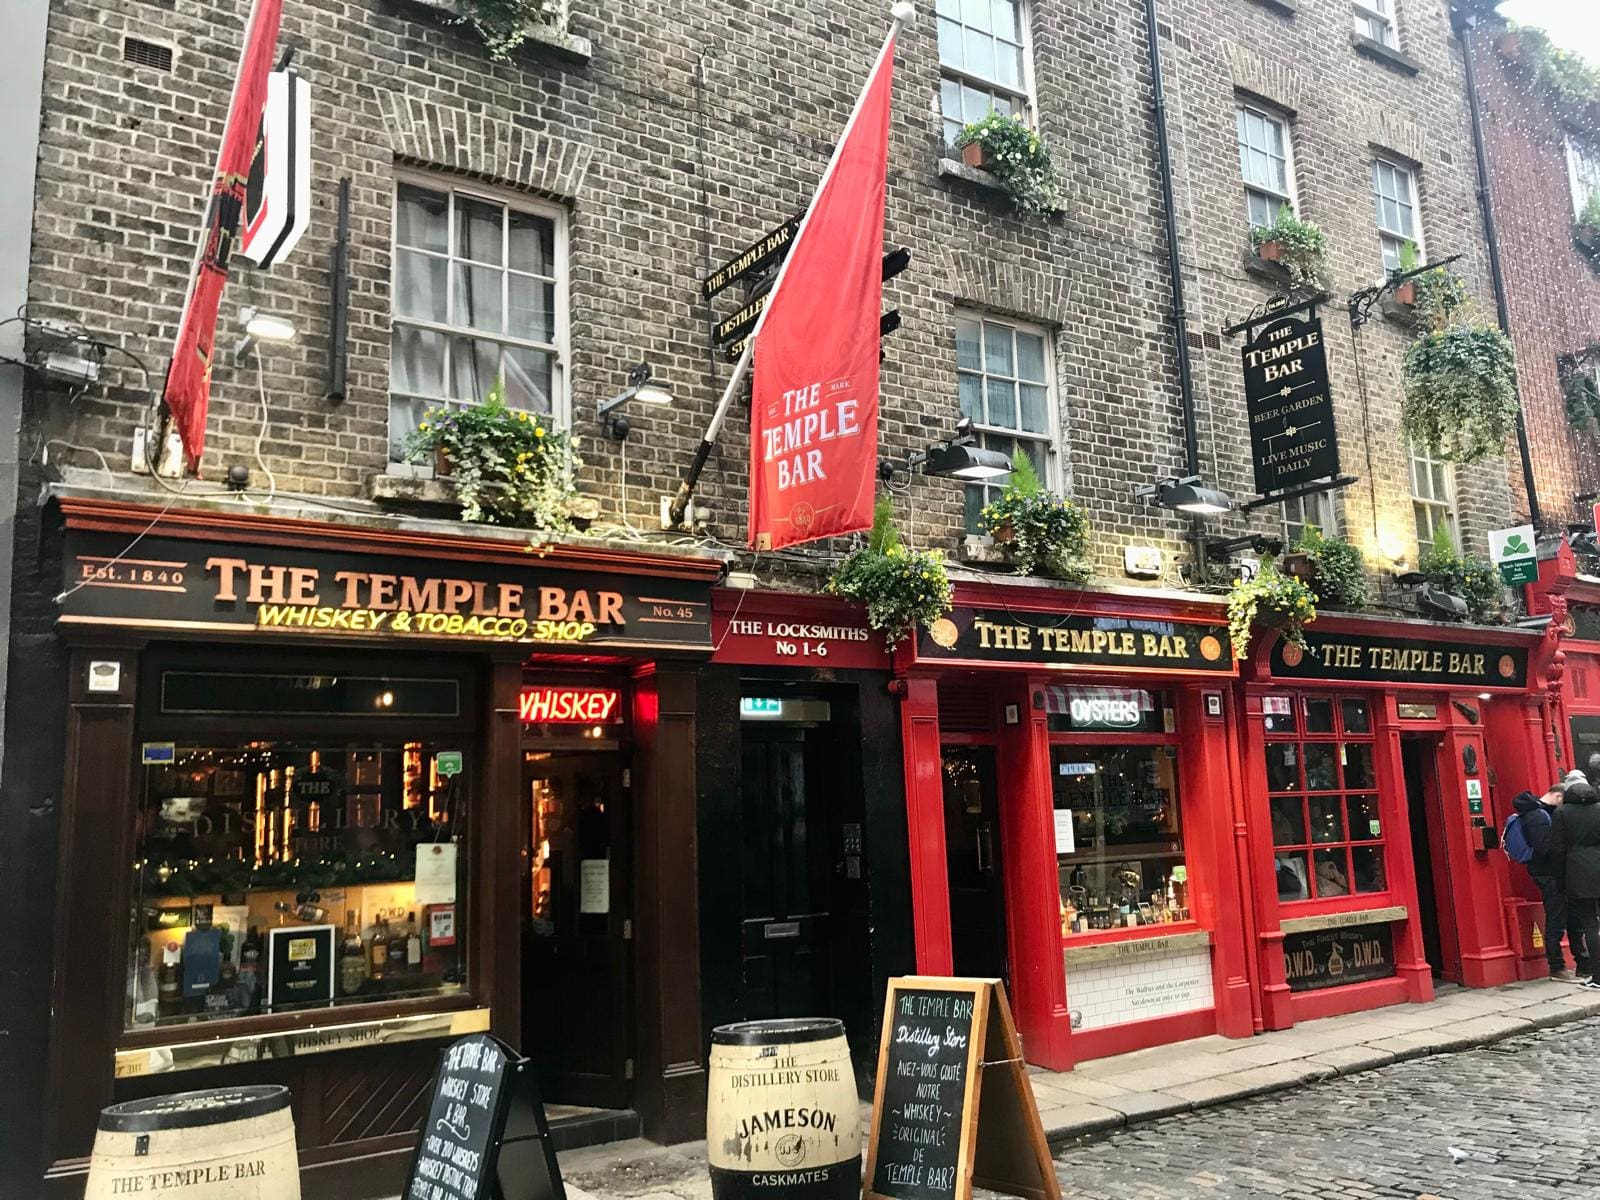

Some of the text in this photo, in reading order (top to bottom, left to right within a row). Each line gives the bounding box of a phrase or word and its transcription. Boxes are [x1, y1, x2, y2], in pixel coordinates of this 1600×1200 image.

[706, 227, 789, 293] THE TEMPLE BAR
[1267, 325, 1293, 342] THE
[1245, 332, 1319, 369] TEMPLE
[1264, 359, 1304, 384] BAR
[783, 383, 821, 417] THE
[1254, 394, 1324, 423] BEER GARDEN
[762, 400, 860, 463] TEMPLE
[1261, 439, 1327, 466] LIVE MUSIC
[778, 449, 827, 491] BAR
[1277, 457, 1312, 476] DAILY
[130, 568, 184, 585] 1840
[204, 557, 626, 625] THE TEMPLE BAR
[258, 603, 597, 641] WHISKEY & TOBACCO SHOP
[653, 605, 693, 619] No. 45
[729, 620, 869, 641] THE LOCKSMITHS
[974, 620, 1190, 658] THE TEMPLE BAR
[775, 641, 828, 657] No 1-6
[1321, 643, 1486, 675] THE TEMPLE BAR
[1070, 697, 1140, 723] OYSTERS
[298, 781, 331, 794] THE
[1118, 944, 1129, 954] THE
[1157, 940, 1170, 949] BAR
[1353, 939, 1384, 968] D.W.D.
[1155, 983, 1165, 991] and
[899, 995, 973, 1019] THE TEMPLE BAR
[348, 1028, 381, 1043] SHOP
[895, 1024, 966, 1057] Distillery Store
[447, 1045, 463, 1071] THE
[480, 1046, 498, 1073] BAR
[774, 1056, 798, 1069] THE
[897, 1060, 938, 1079] AVEZ-VOUS
[731, 1068, 840, 1089] DISTILLERY STORE
[440, 1077, 493, 1110] WHISKEY STORE
[916, 1083, 941, 1101] NOTRE
[452, 1103, 468, 1128] BAR
[739, 1108, 836, 1139] JAMESON
[903, 1103, 943, 1122] WHISKEY
[898, 1126, 941, 1146] ORIGINAL
[912, 1148, 925, 1163] DE
[112, 1160, 266, 1194] THE TEMPLE BAR
[752, 1169, 829, 1187] CASKMATES
[885, 1162, 955, 1189] TEMPLE BAR?
